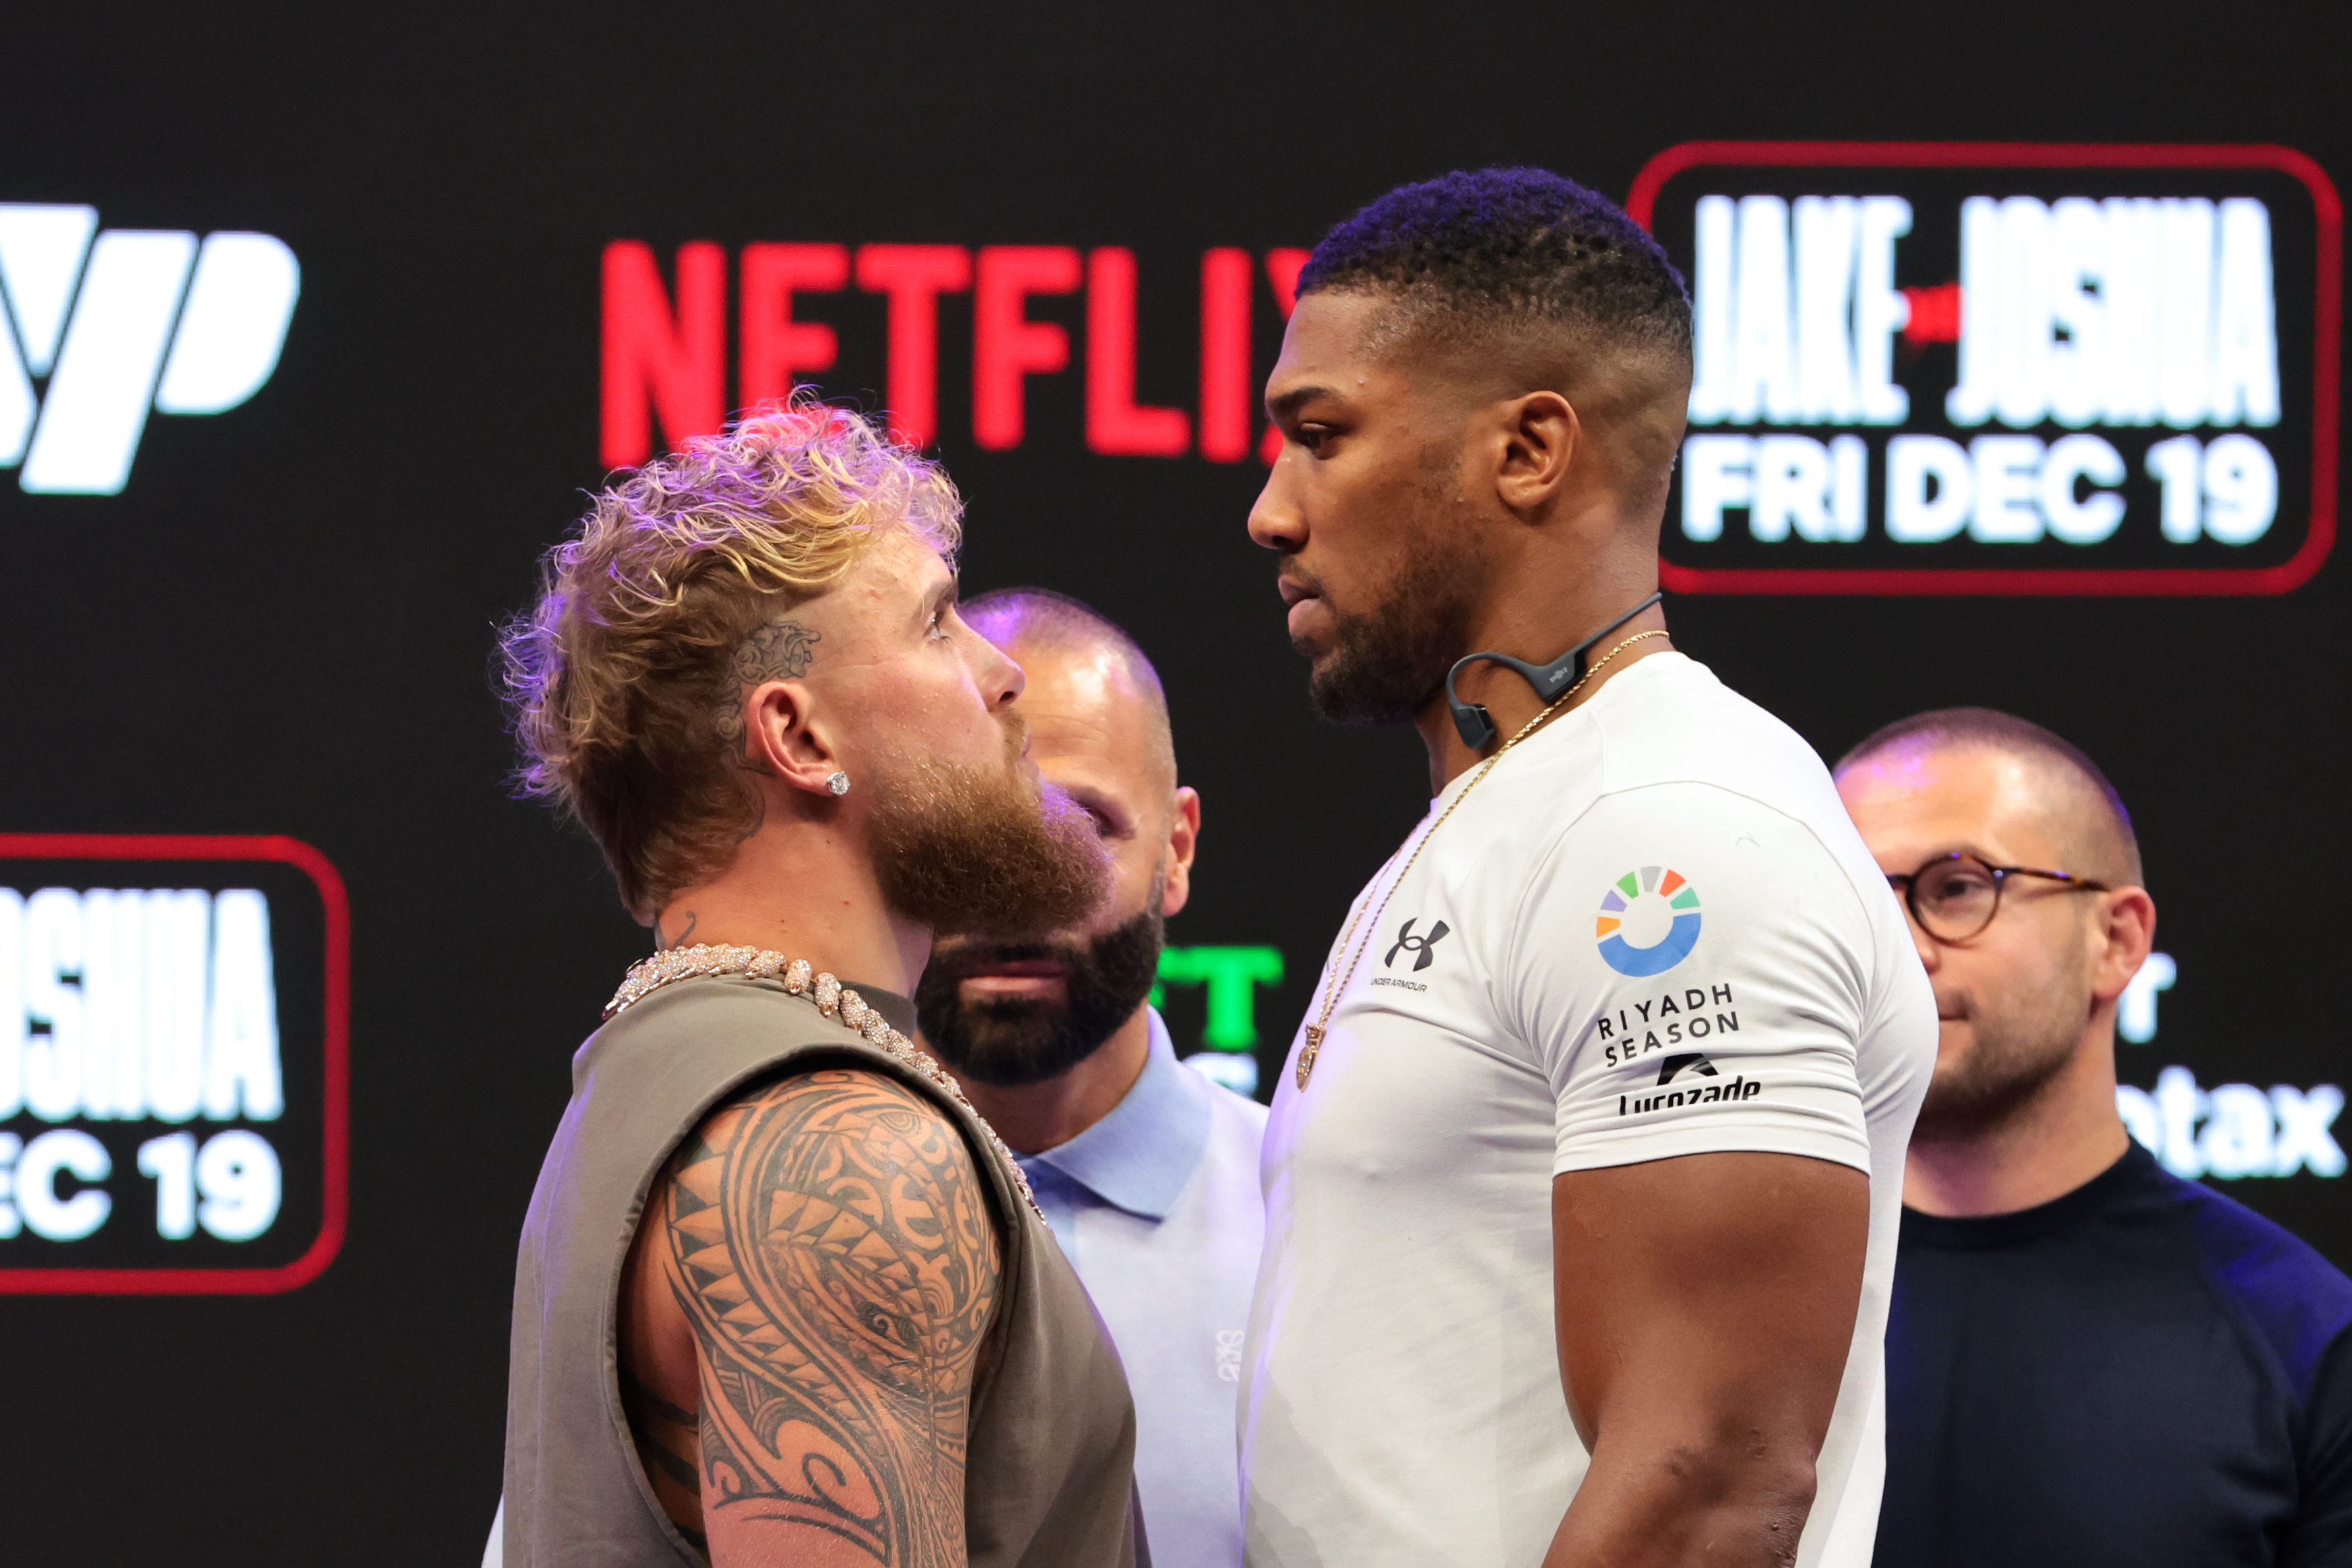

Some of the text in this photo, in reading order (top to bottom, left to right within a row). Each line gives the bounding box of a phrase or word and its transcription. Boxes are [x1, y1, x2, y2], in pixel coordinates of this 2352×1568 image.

[0, 201, 302, 496] VP
[1688, 195, 2283, 429] JAKE JOSHUA
[1681, 432, 2279, 547] FRI DEC 19
[0, 887, 285, 1124] SHUA
[1371, 977, 1428, 992] UNDER ARMOUR
[1597, 982, 1733, 1040] RIYADH
[1604, 1010, 1739, 1068] SEASON
[136, 1128, 282, 1242] 19
